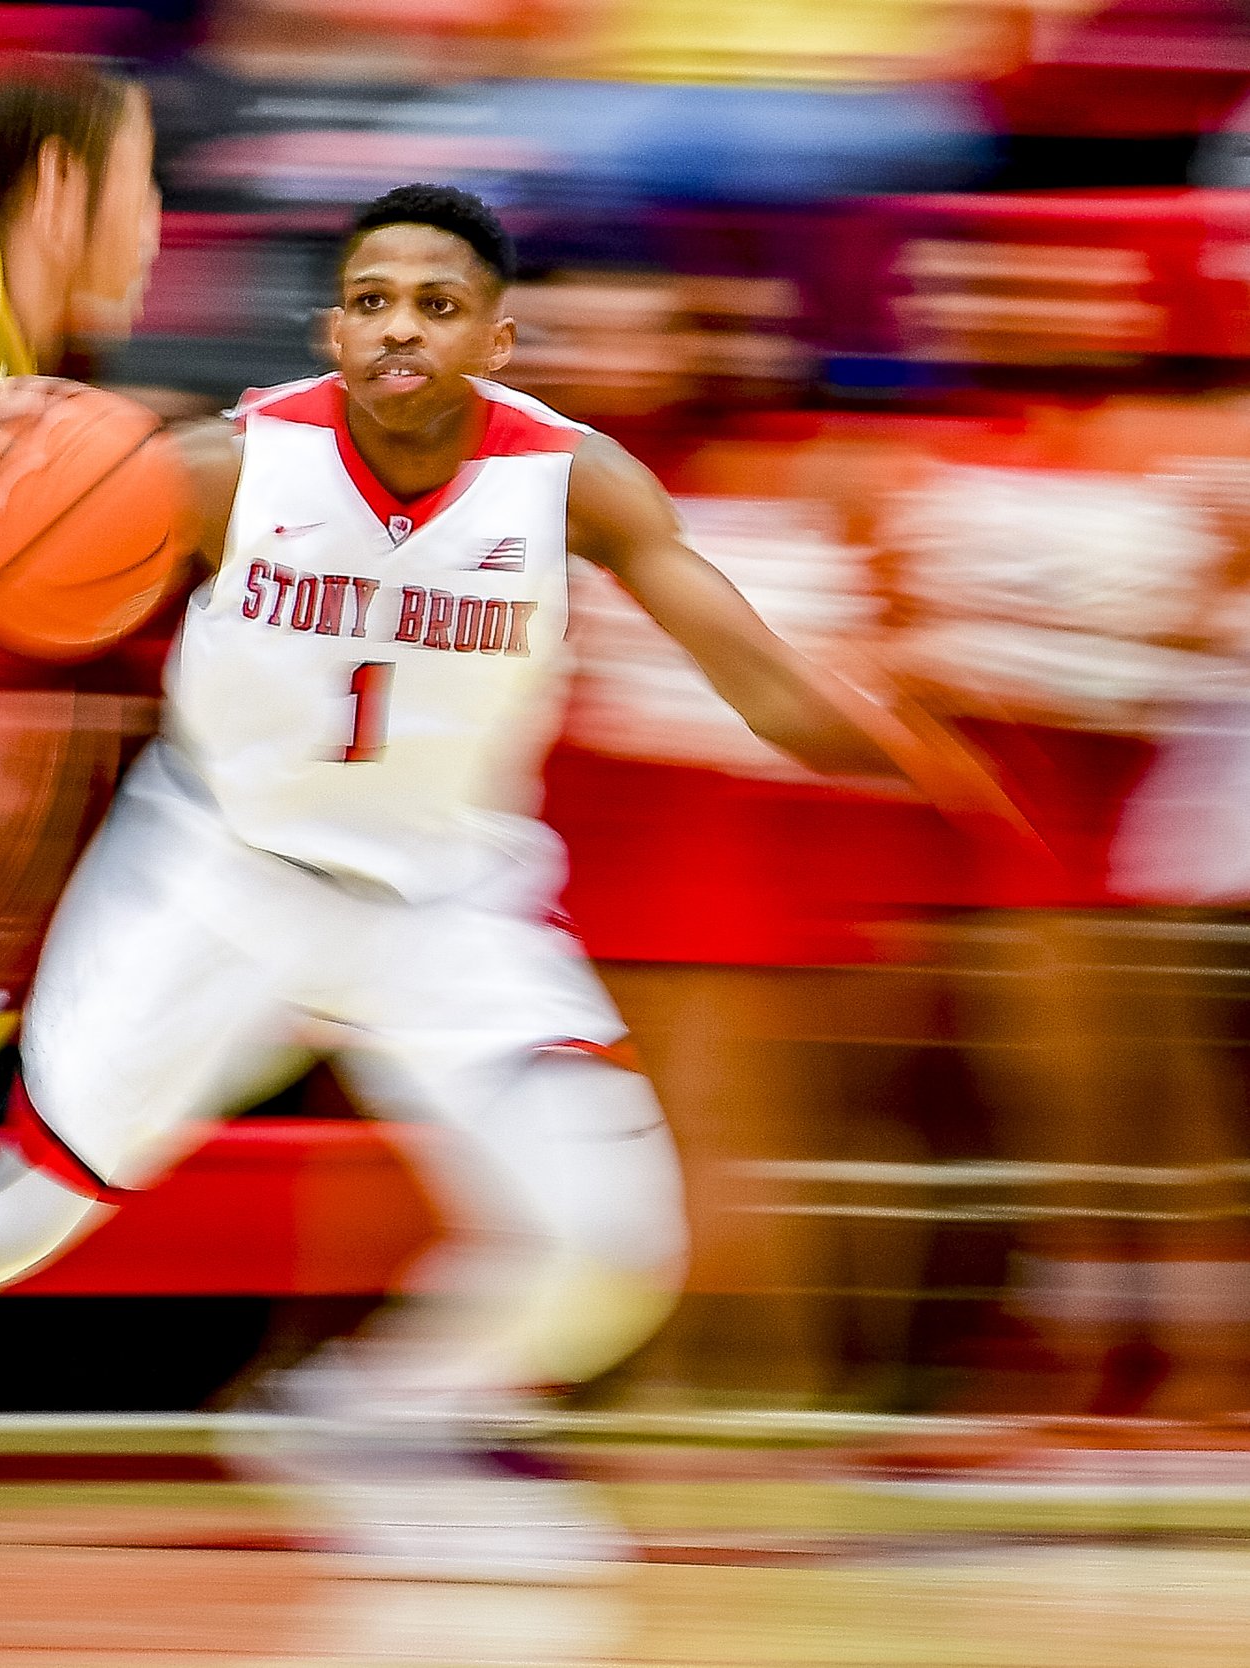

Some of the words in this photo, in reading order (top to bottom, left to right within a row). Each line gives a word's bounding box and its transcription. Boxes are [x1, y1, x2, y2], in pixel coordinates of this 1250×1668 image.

[242, 557, 381, 638] STONY
[394, 585, 538, 658] BROOK
[338, 660, 396, 764] 1
